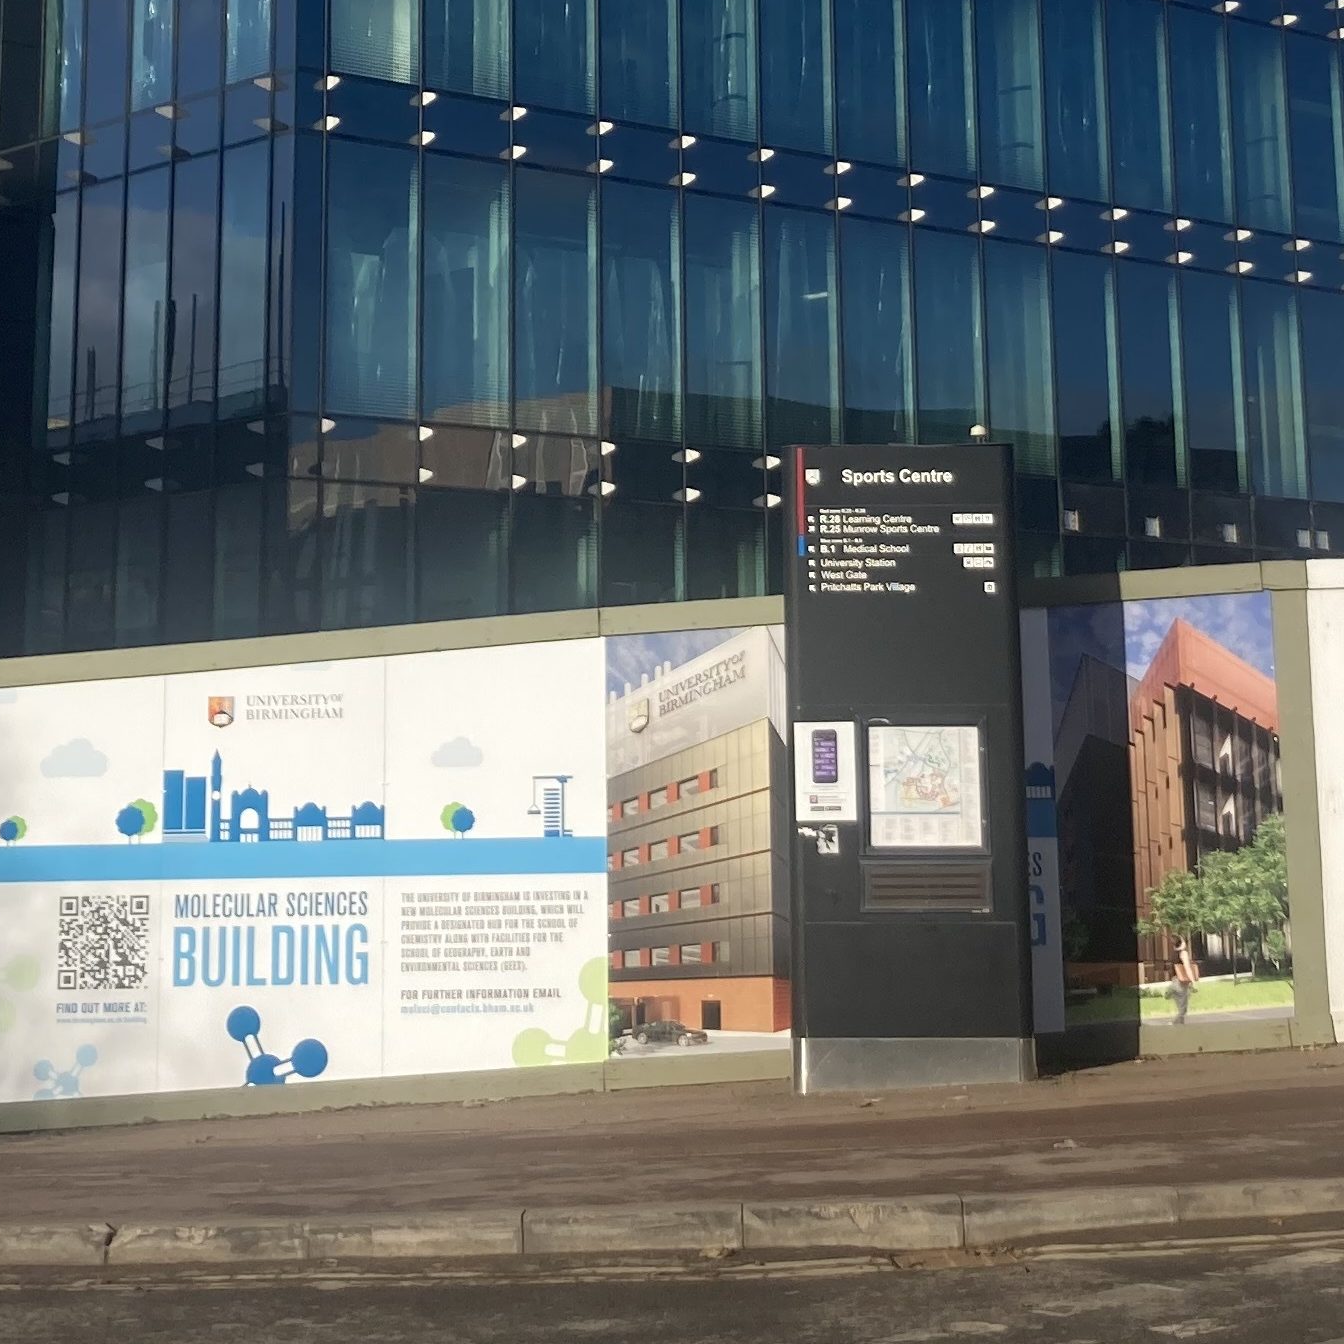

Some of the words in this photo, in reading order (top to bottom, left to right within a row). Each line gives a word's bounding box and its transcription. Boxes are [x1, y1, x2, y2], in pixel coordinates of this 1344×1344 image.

[841, 468, 895, 487] Sports
[899, 467, 953, 484] Centre
[842, 513, 881, 526] Learning
[882, 513, 913, 524] Centre
[842, 525, 878, 534] Munrow
[879, 524, 909, 536] Sports
[910, 524, 940, 534] Centre
[820, 544, 837, 554] B.1
[843, 543, 878, 554] Medical
[879, 543, 910, 554] School
[820, 557, 864, 569] University
[864, 557, 896, 568] Station
[820, 569, 845, 580] West
[845, 569, 868, 580] Gate
[863, 581, 885, 592] Park
[886, 581, 916, 594] Village
[659, 659, 731, 703] UNIVERSITY
[659, 665, 746, 717] BIRMINGHAM
[246, 693, 329, 707] UNIVERSITY
[330, 693, 344, 703] OF
[246, 706, 344, 721] BIRMINGHAM
[401, 892, 415, 903] THE
[417, 892, 459, 903] UNIVERSITY
[461, 891, 471, 902] OF
[473, 891, 521, 902] BIRMINGHAM
[523, 891, 531, 901] IS
[533, 890, 571, 901] INVESTING
[573, 890, 581, 900] IN
[583, 890, 589, 900] A
[175, 892, 279, 919] MOLECULAR
[286, 890, 368, 917] SCIENCES
[401, 906, 417, 917] NEW
[419, 905, 462, 916] MOLECULAR
[464, 905, 500, 916] SCIENCES
[540, 904, 564, 914] WHICH
[566, 904, 584, 914] WILL
[401, 920, 431, 930] PROVIDE
[433, 920, 439, 930] A
[441, 919, 485, 930] DESIGNATED
[487, 919, 502, 929] HUB
[504, 919, 519, 929] FOR
[521, 918, 535, 928] THE
[537, 918, 566, 929] SCHOOL
[568, 918, 579, 928] OF
[401, 934, 442, 945] CHEMISTRY
[444, 933, 468, 944] ALONG
[470, 933, 490, 943] WITH
[491, 933, 531, 943] FACILITIES
[532, 932, 547, 943] FOR
[549, 932, 564, 943] THE
[173, 923, 369, 987] BUILDING
[401, 948, 429, 958] SCHOOL
[431, 947, 441, 958] OF
[490, 946, 513, 957] EARTH
[515, 946, 531, 957] AND
[401, 961, 460, 973] ENVIRONMENTAL
[463, 960, 499, 972] SCIENCES
[400, 989, 418, 1001] FOR
[421, 989, 463, 1000] FURTHER
[465, 988, 529, 1000] INFORMATION
[532, 987, 562, 999] EMAIL
[56, 1003, 78, 1014] FIND
[81, 1002, 100, 1014] OUT
[102, 1002, 131, 1013] MORE
